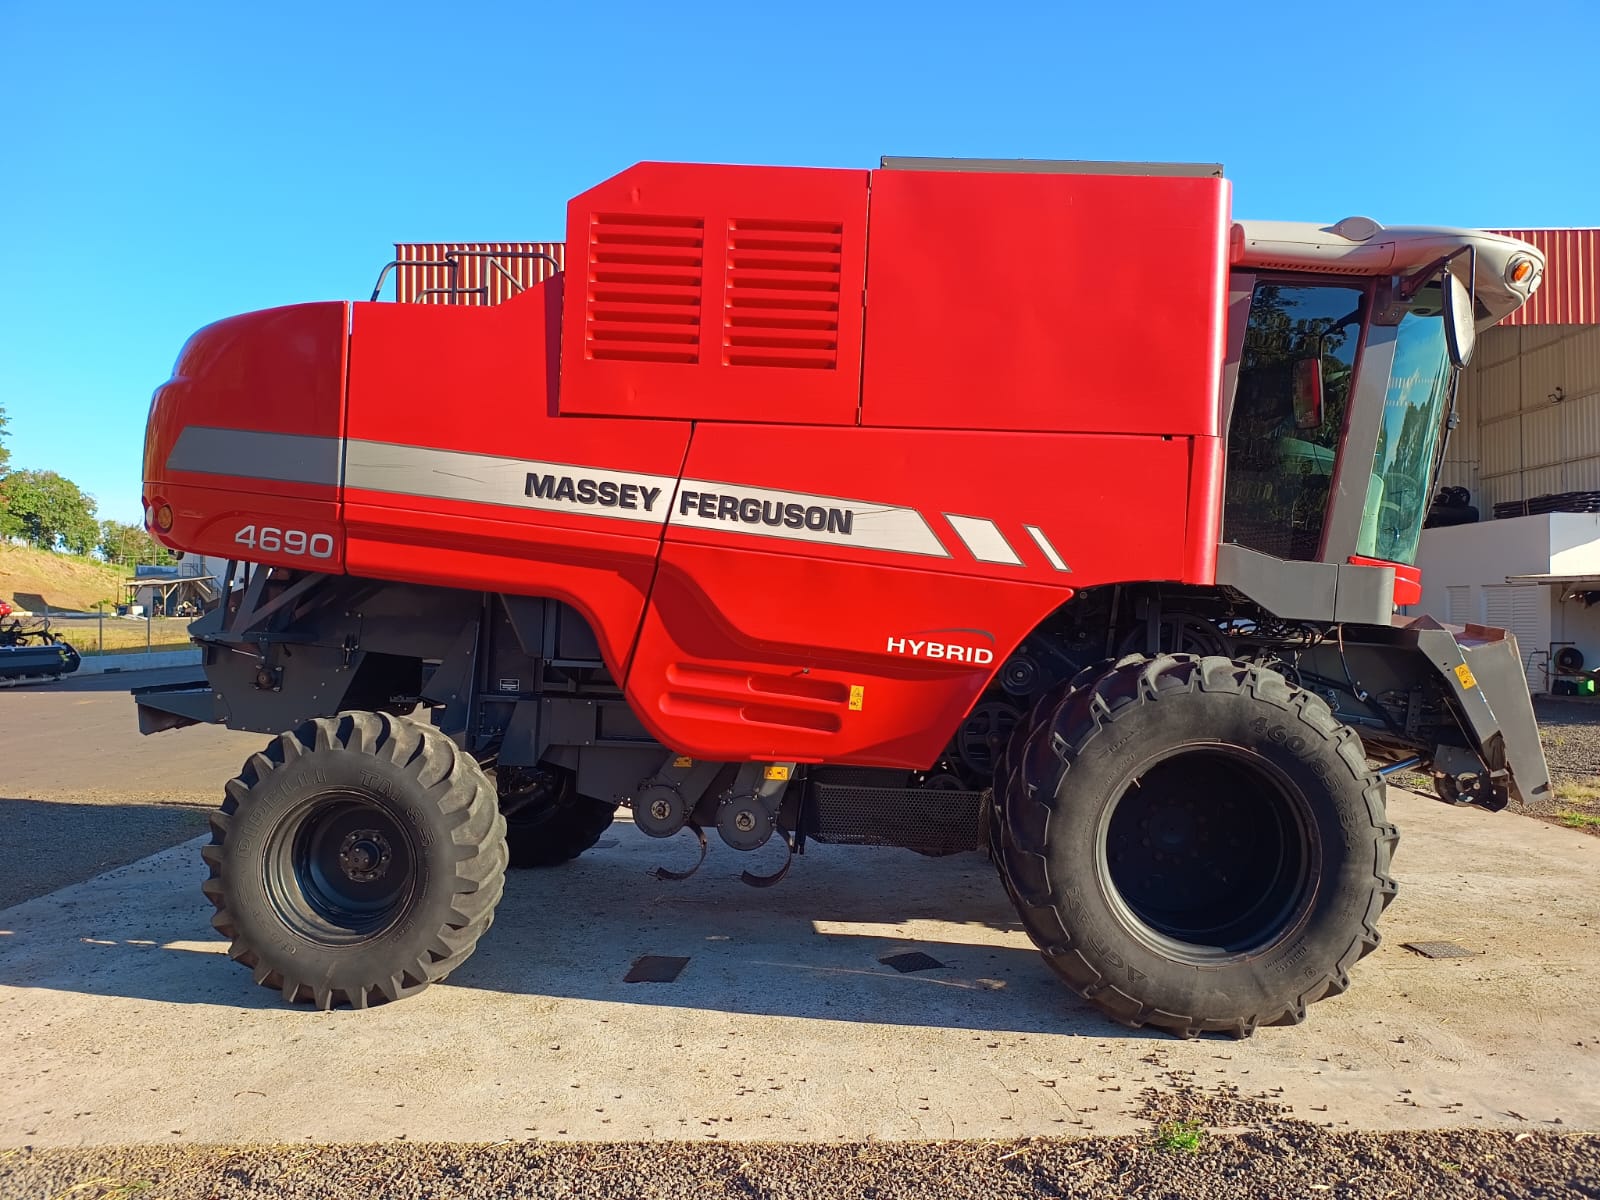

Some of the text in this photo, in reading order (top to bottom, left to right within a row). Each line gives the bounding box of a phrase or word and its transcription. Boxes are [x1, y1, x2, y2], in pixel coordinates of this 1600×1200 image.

[524, 472, 853, 534] MASSEY FERGUSON
[234, 525, 334, 558] 4690
[887, 636, 994, 664] HYBRID
